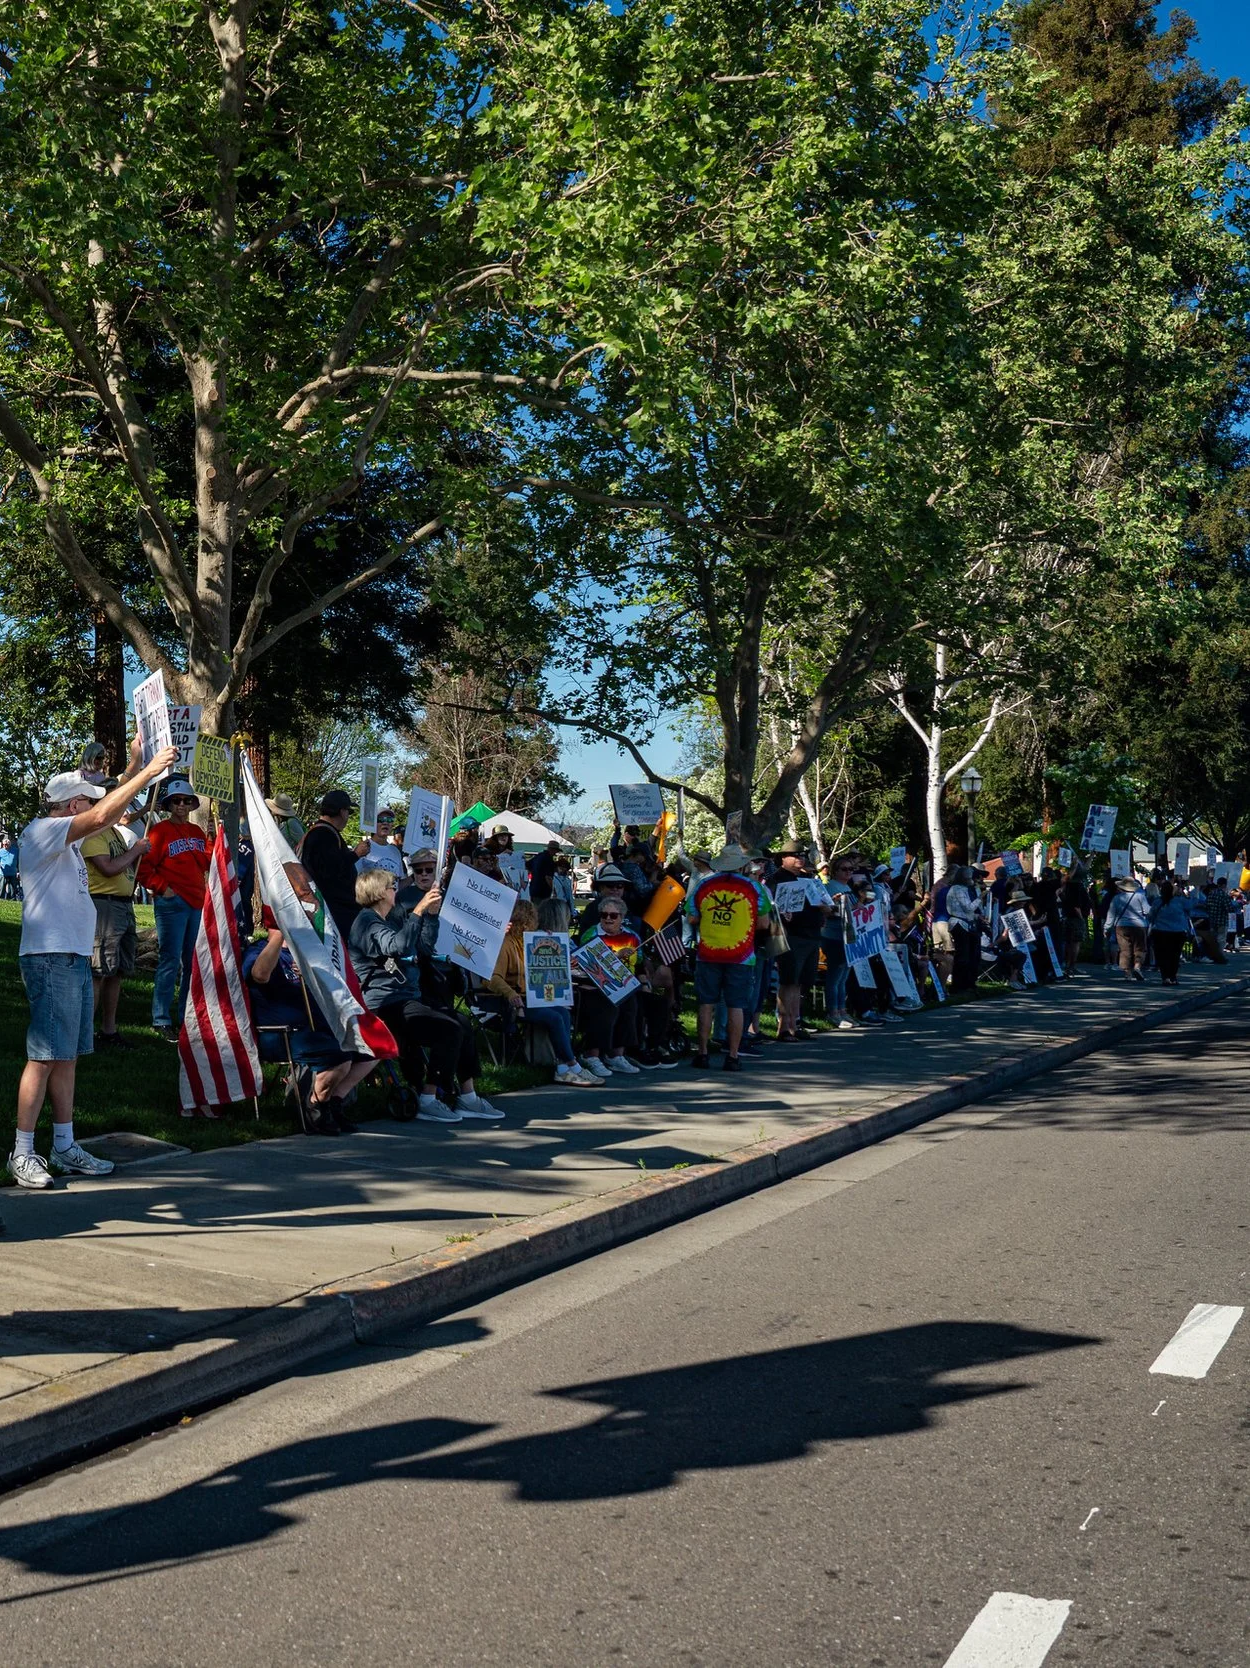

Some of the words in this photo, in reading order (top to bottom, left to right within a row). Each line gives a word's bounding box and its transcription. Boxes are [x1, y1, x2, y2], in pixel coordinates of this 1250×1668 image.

[181, 708, 190, 720] A
[170, 722, 195, 734] STILL
[202, 744, 226, 762] DEFEND
[208, 760, 220, 774] OUR
[196, 770, 231, 790] DEMOCRACY
[467, 878, 478, 889] No
[480, 884, 501, 900] Liars!
[451, 897, 462, 908] No
[463, 902, 502, 926] Pedophiles!
[713, 911, 732, 921] NO
[452, 923, 463, 933] No
[465, 929, 487, 946] Kings!
[527, 955, 567, 966] JUSTICE
